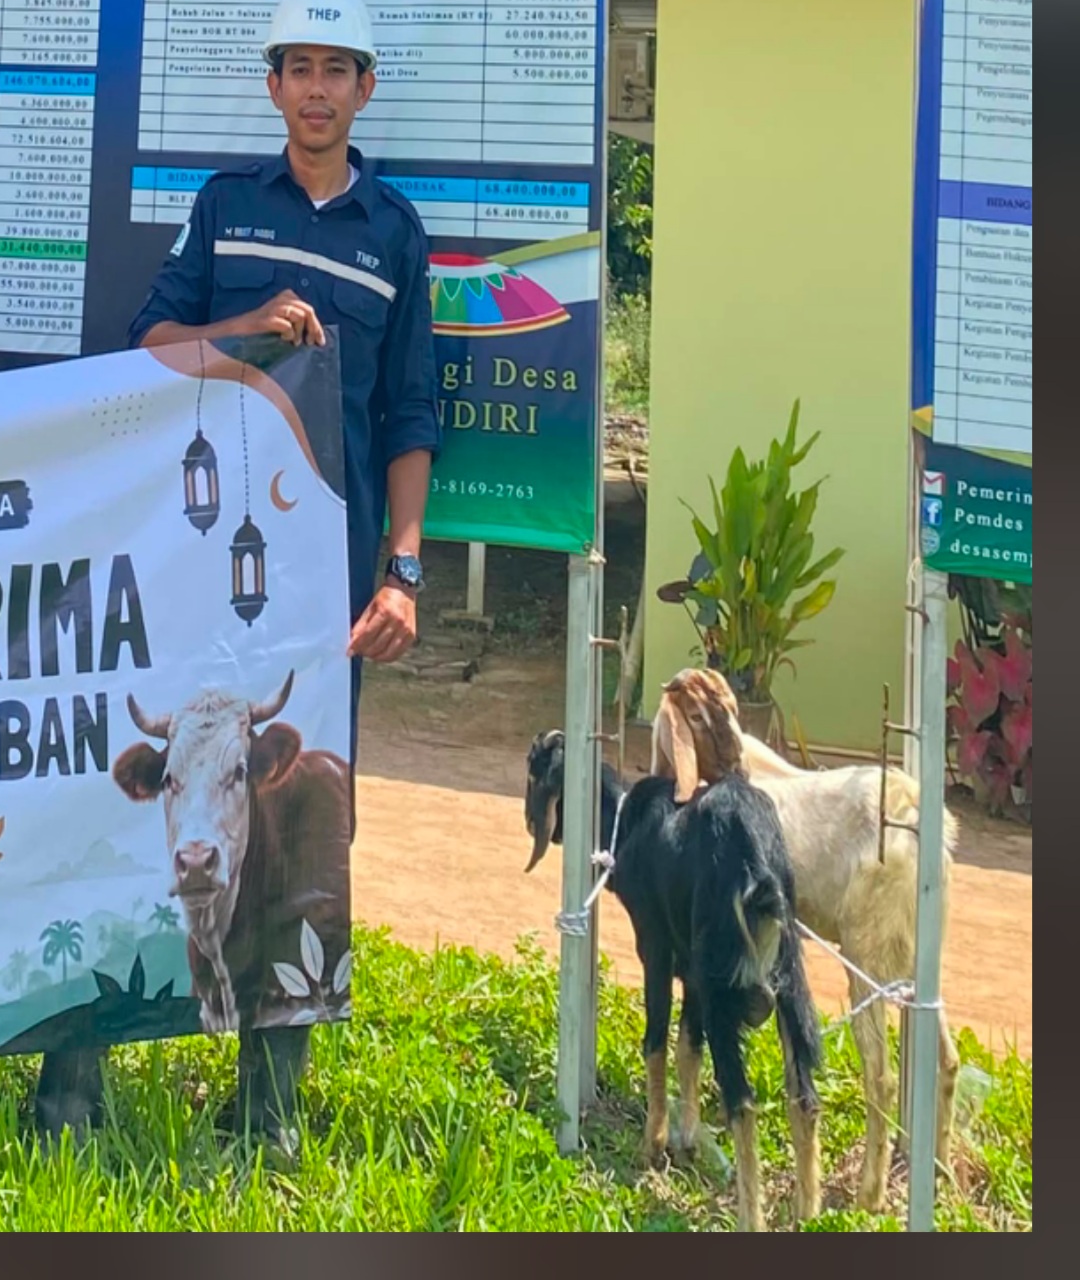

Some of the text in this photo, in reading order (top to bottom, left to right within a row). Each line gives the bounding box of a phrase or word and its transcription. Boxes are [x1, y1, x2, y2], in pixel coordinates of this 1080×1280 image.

[307, 8, 341, 22] THEP
[168, 172, 208, 182] BIDAN
[356, 250, 380, 270] THEP
[493, 358, 577, 390] Desa
[955, 507, 1023, 531] Pemdes
[950, 539, 1032, 568] desasem
